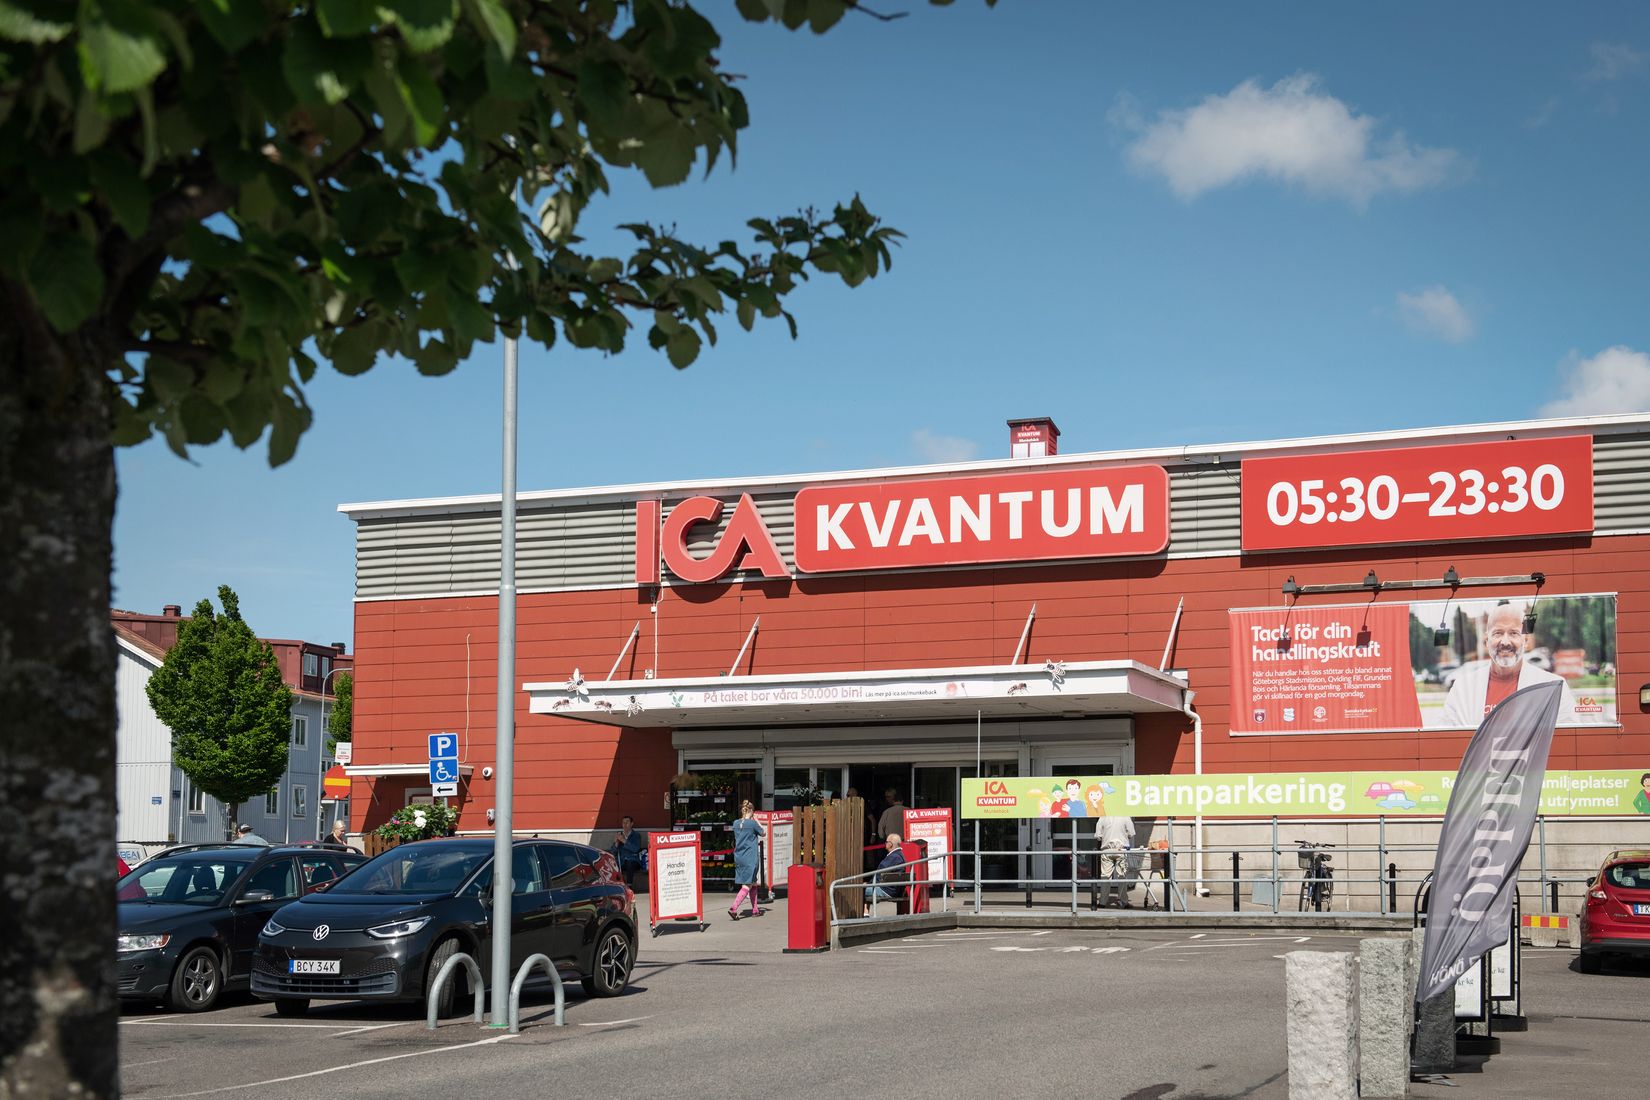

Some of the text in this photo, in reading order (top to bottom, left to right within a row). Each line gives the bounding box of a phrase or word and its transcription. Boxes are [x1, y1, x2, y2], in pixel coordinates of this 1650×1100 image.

[635, 483, 1144, 583] ICA KVANTUM
[1250, 622, 1352, 641] Tack för din
[1252, 641, 1381, 663] handlingskraft
[1274, 669, 1297, 677] handlar
[1322, 667, 1344, 675] stöttar
[1354, 666, 1373, 674] bland
[1373, 665, 1392, 673] annat
[1252, 677, 1285, 686] Göteborgs
[1363, 673, 1392, 681] Grunden
[703, 685, 863, 703] På taket bor våra 50.000 bin!
[1252, 694, 1264, 702] gör
[1271, 691, 1294, 700] skillnad
[1294, 691, 1304, 699] för
[1313, 690, 1327, 700] god
[1579, 697, 1596, 706] ICA
[437, 737, 451, 756] P
[984, 781, 1009, 795] ICA
[1125, 775, 1346, 812] Barnparkering
[978, 797, 1015, 805] KVANTUM
[1547, 795, 1619, 810] utrymme!
[905, 810, 919, 819] ICA
[1451, 735, 1531, 922] ÖPPET
[656, 835, 669, 844] ICA
[296, 961, 336, 972] BCY 34K
